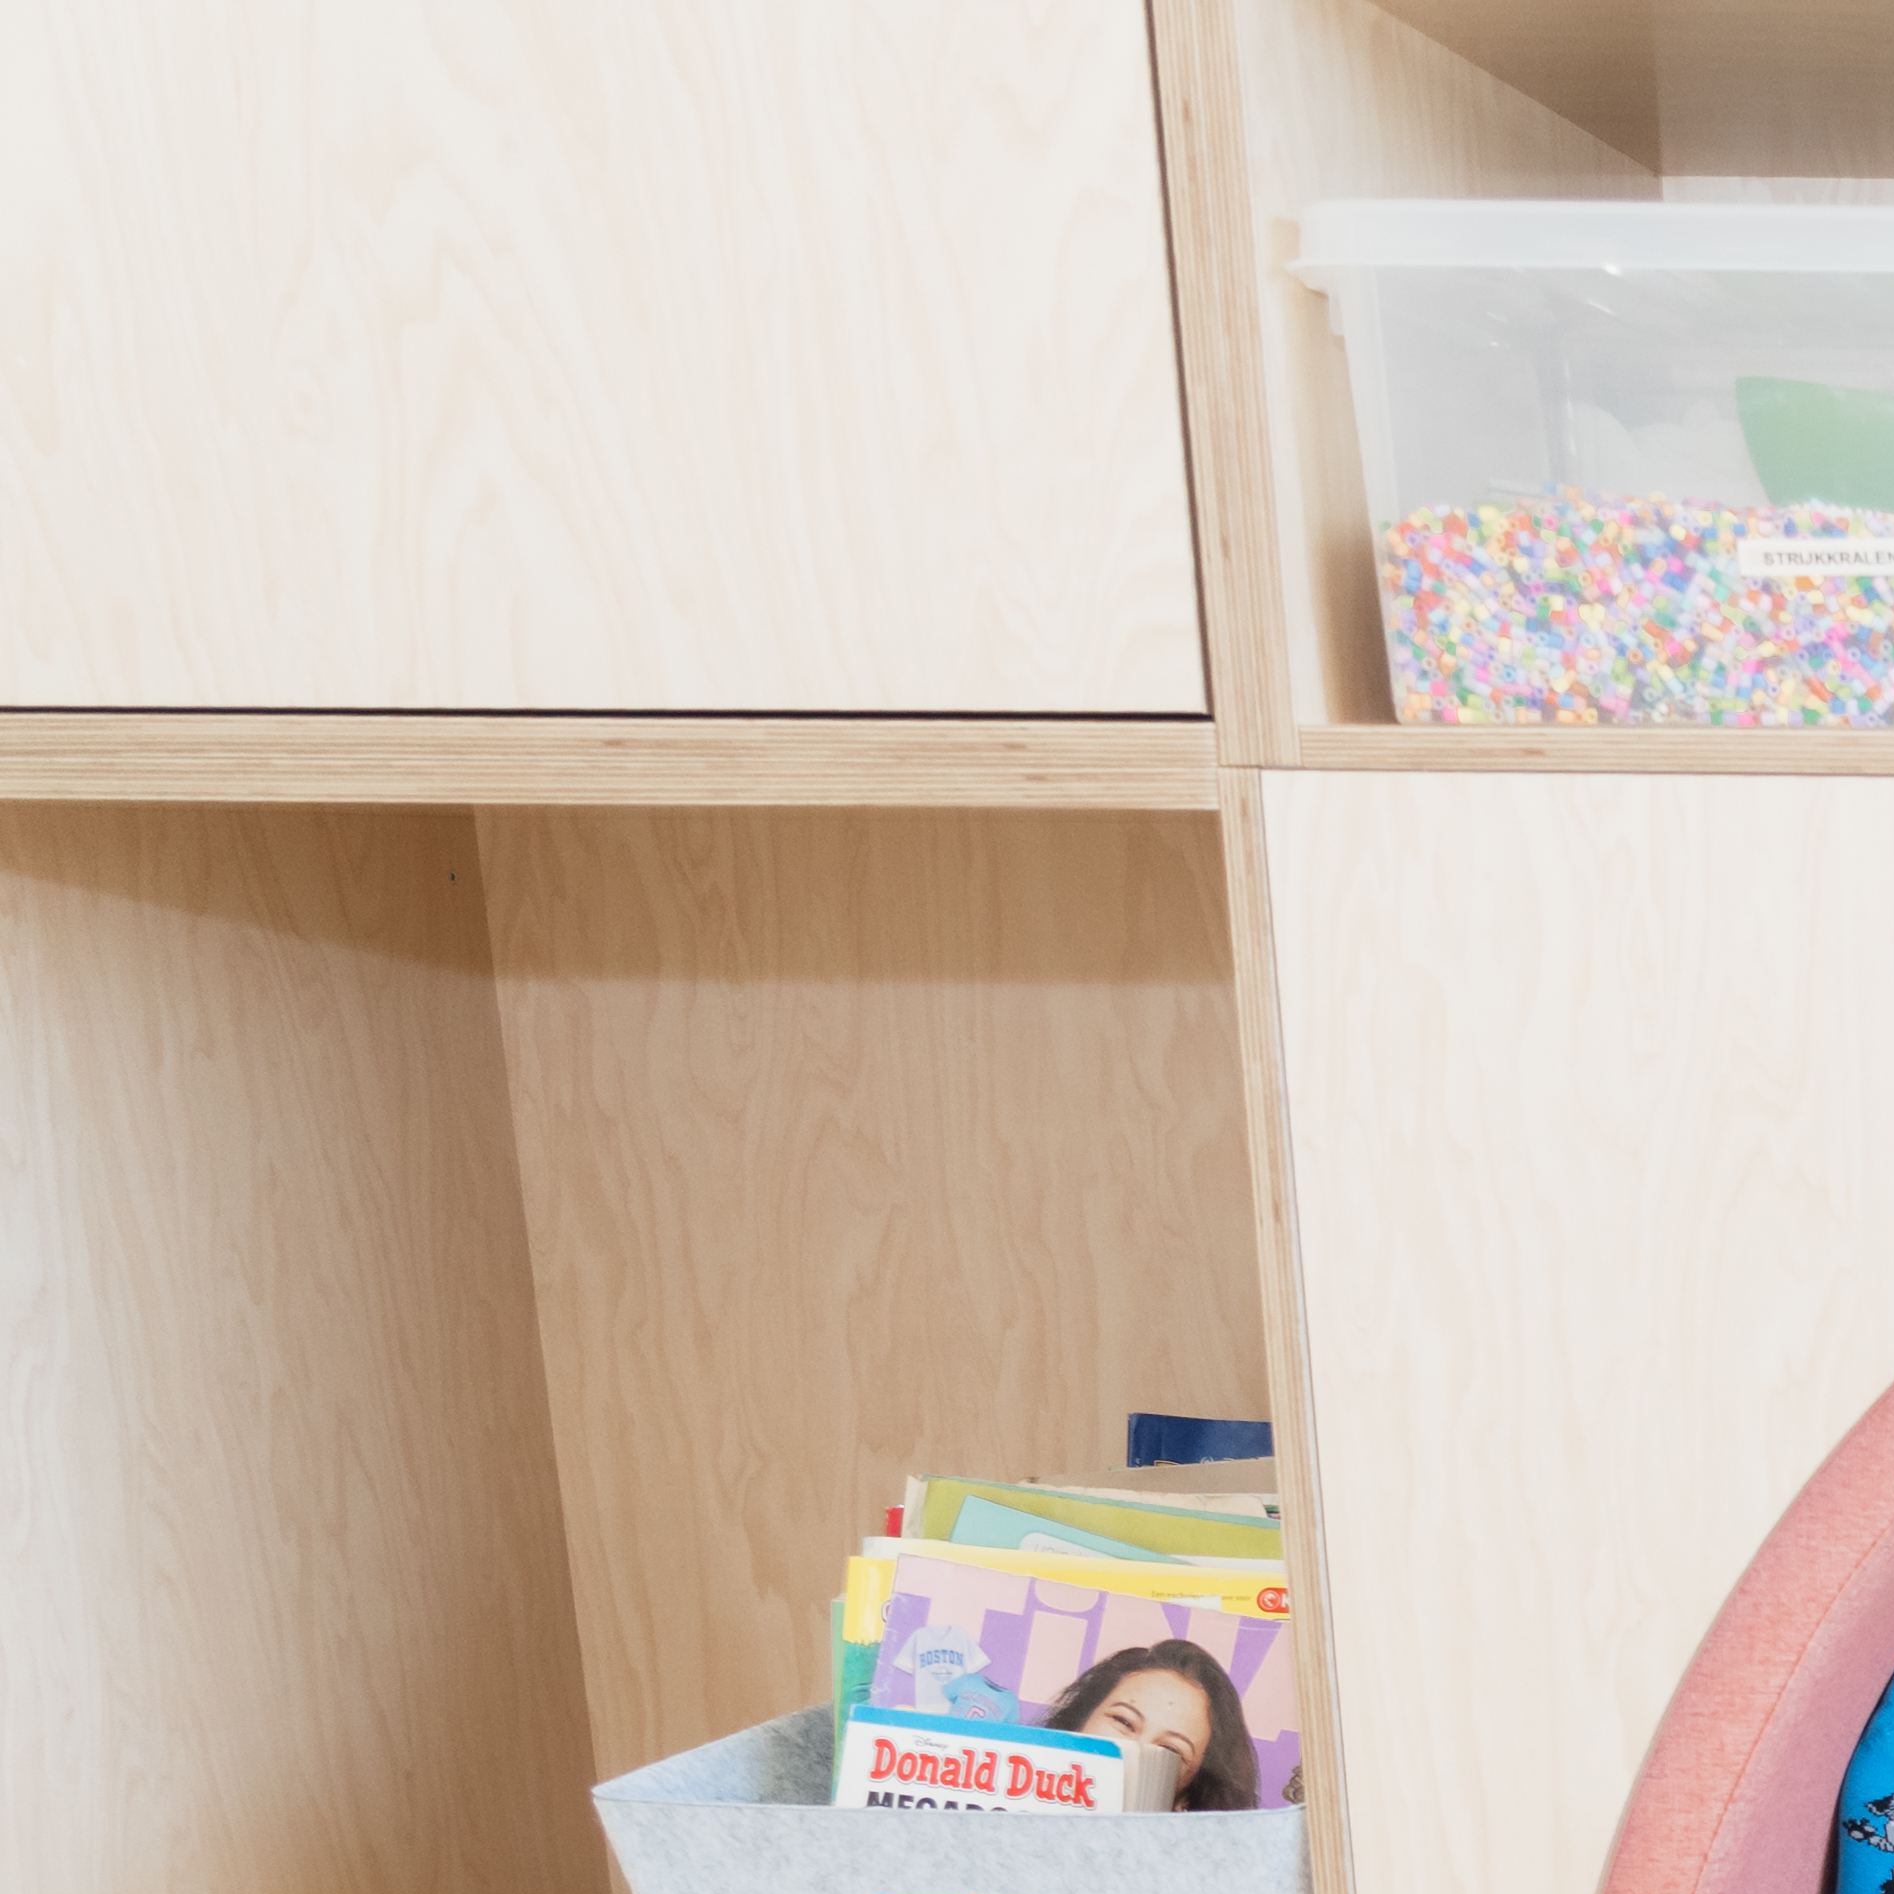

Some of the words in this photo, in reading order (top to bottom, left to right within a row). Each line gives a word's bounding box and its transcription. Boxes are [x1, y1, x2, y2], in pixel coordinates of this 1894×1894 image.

[919, 1649, 964, 1669] BOSTON
[869, 1737, 998, 1793] Donald
[1005, 1754, 1096, 1810] Duck
